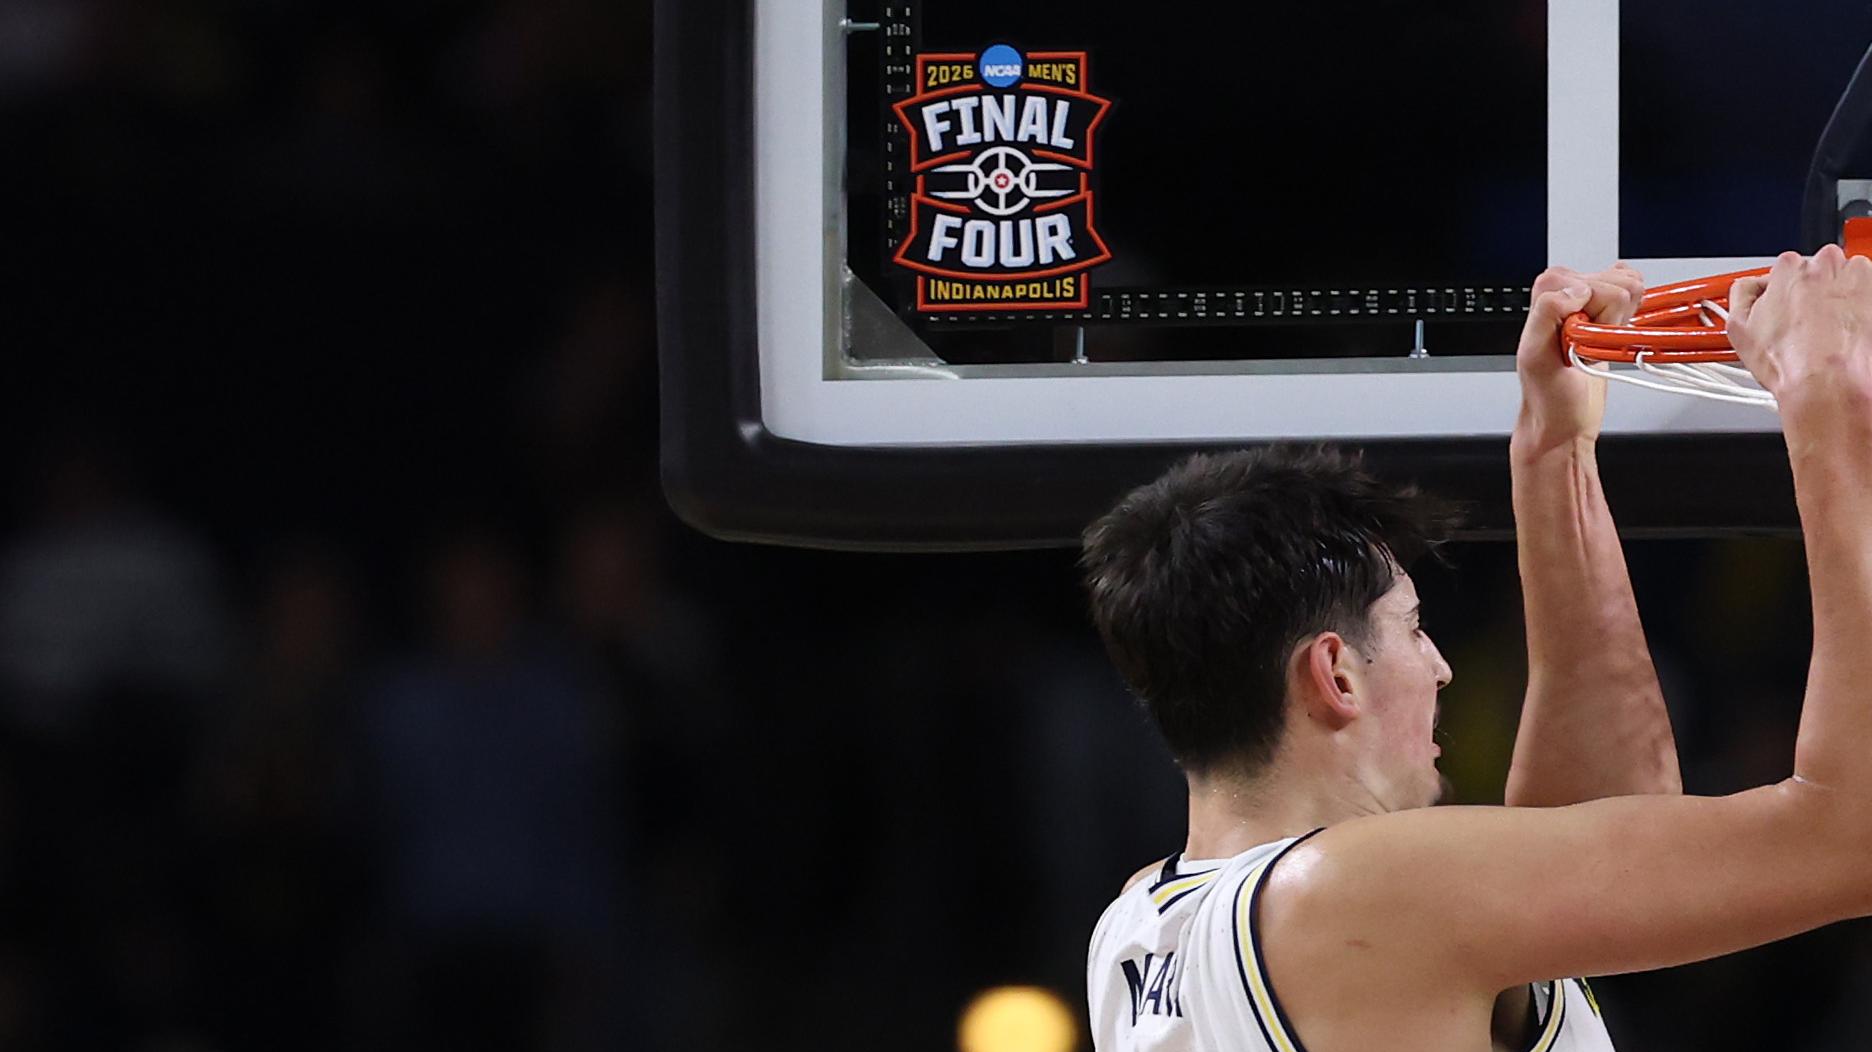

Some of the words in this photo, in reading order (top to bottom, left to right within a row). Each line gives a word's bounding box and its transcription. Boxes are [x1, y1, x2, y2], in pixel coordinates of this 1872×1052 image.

[927, 65, 974, 87] 2026
[984, 64, 1022, 77] NCAA
[1028, 64, 1076, 84] MEN'S
[922, 94, 1074, 151] FINAL
[927, 213, 1076, 268] FOUR
[930, 277, 1075, 299] INDIANAPOLIS
